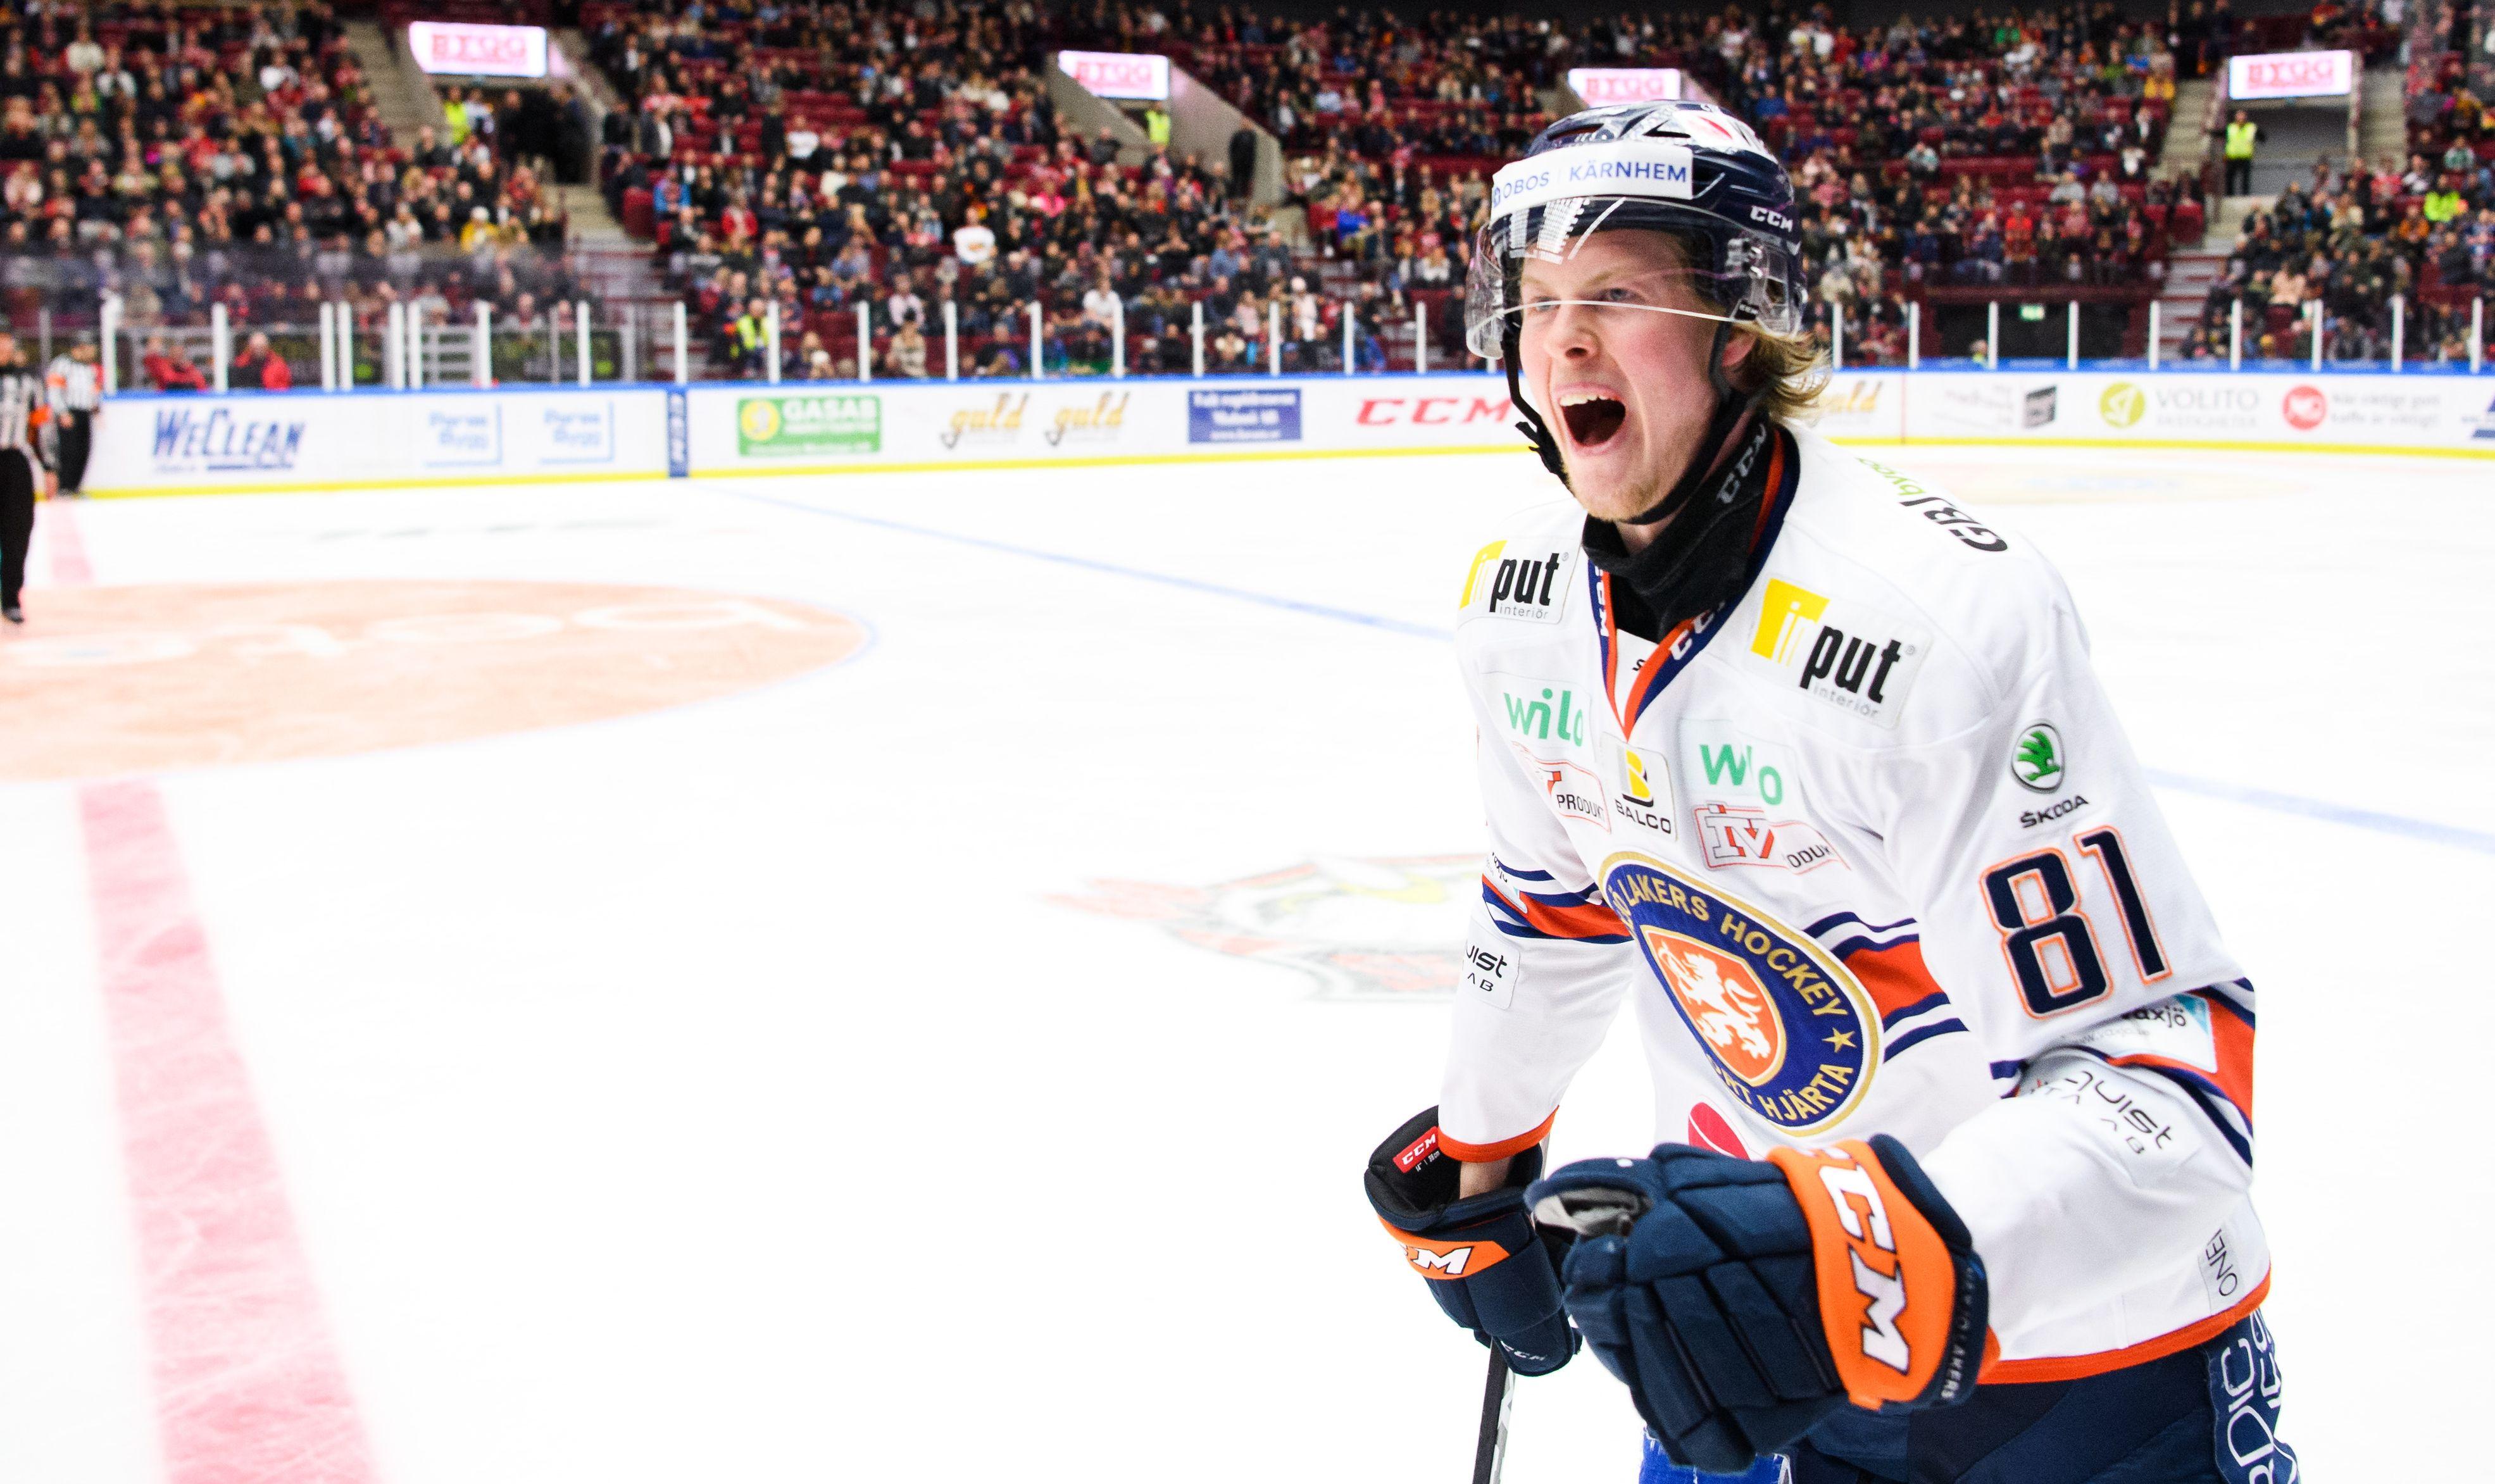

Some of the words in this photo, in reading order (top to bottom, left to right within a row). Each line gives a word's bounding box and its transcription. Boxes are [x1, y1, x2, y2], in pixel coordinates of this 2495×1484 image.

[1504, 172, 1549, 199] OBOS
[1569, 160, 1687, 183] KÄRNHEM
[1750, 205, 1794, 233] CCM
[783, 399, 877, 420] GASAB
[1356, 397, 1512, 426] CCM
[2155, 387, 2261, 411] VOLITO
[1499, 604, 1549, 619] interiör
[1615, 799, 1671, 834] BALCO
[2020, 794, 2088, 829] ŠKODA
[1979, 825, 2173, 1020] 81
[1617, 875, 1710, 922] LAKERS
[1720, 914, 1848, 1016] HOCKEY
[1756, 1063, 1854, 1121] HJÄRTA
[1402, 1133, 1436, 1165] CCM
